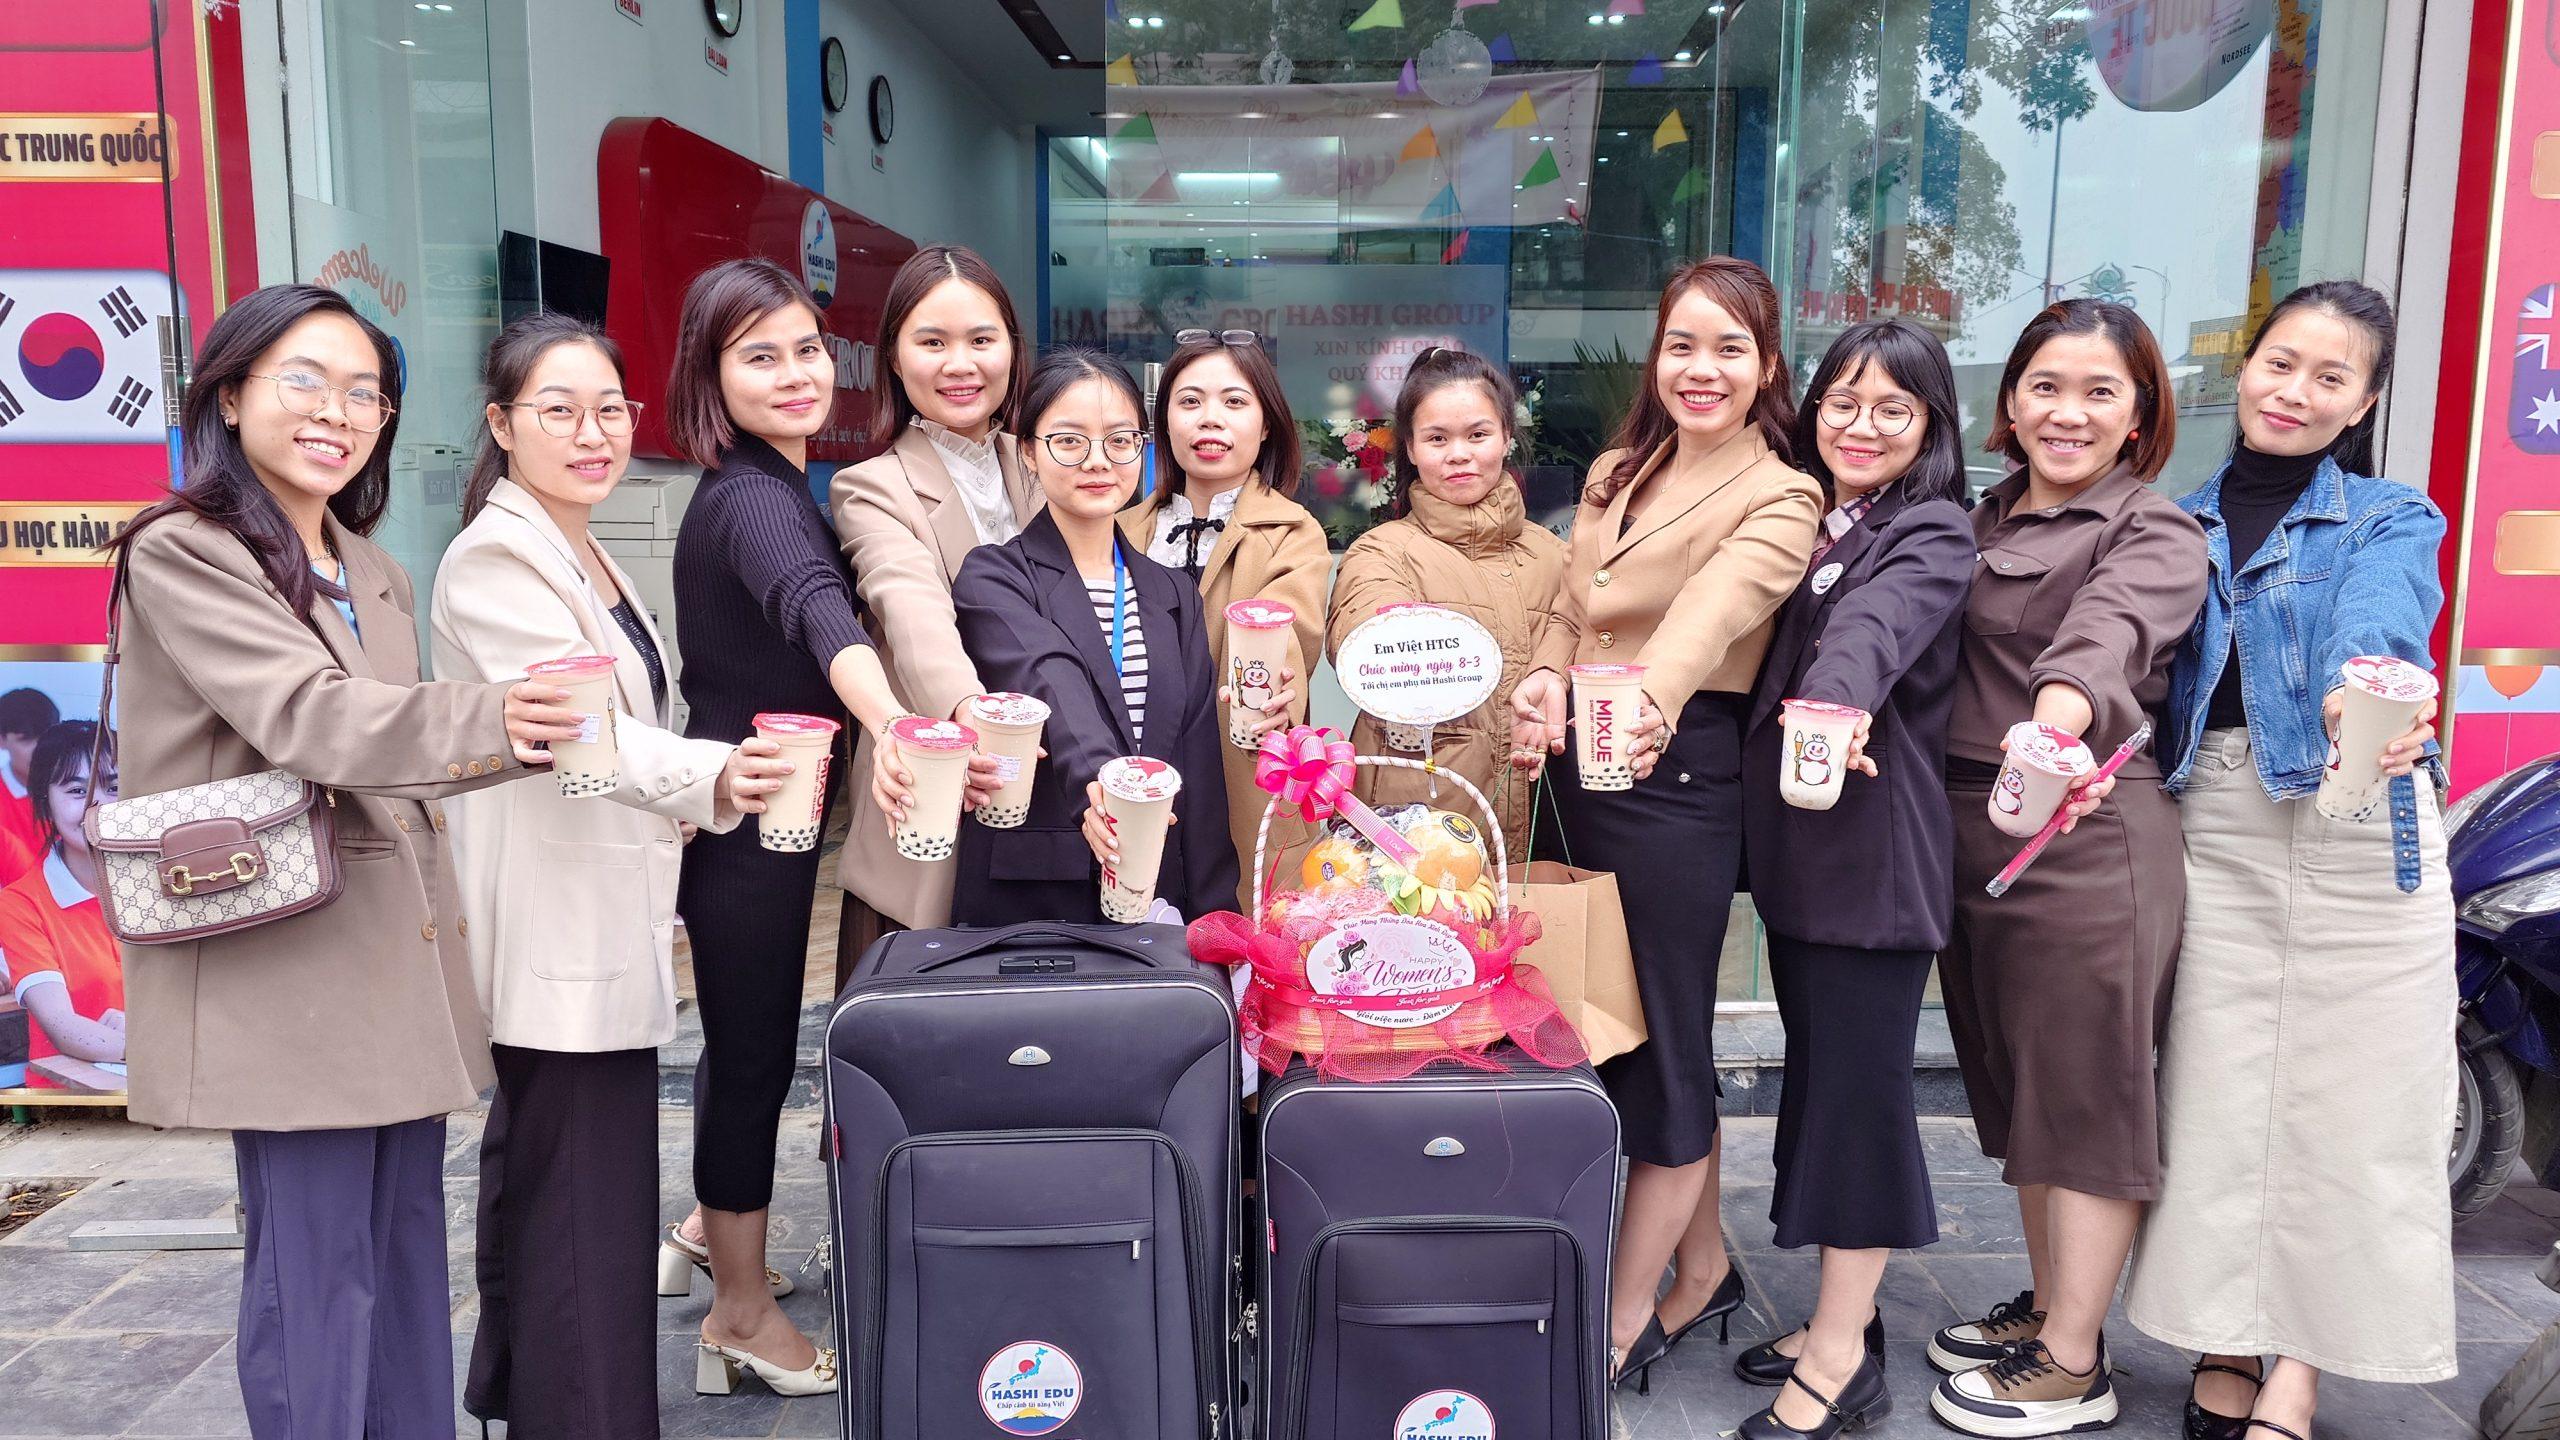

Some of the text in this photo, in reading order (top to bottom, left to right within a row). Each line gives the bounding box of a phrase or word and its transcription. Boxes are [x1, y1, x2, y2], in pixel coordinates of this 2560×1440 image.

[2221, 44, 2251, 65] NORDSEE
[15, 133, 95, 162] TRUNG
[100, 120, 162, 167] QUỐC
[1285, 303, 1495, 327] HASHI GROUP
[1314, 341, 1348, 356] XIN
[1356, 334, 1407, 356] KÍNH
[1328, 361, 1368, 382] QUÝ
[14, 521, 58, 556] HỌC
[62, 513, 111, 548] HÀN
[1374, 637, 1460, 655] Em Việt HTCS
[1359, 656, 1481, 676] Chúc mừng ngày 8-3
[1361, 682, 1375, 690] Tới
[1376, 681, 1389, 691] chị
[1403, 679, 1419, 689] phụ
[1432, 676, 1456, 685] Hashi
[1457, 674, 1483, 684] Group
[1596, 700, 1613, 762] MIXUE
[815, 756, 830, 821] MIXUE
[1408, 956, 1444, 965] HAPPY
[1366, 960, 1460, 987] Women's
[992, 1388, 1074, 1400] HASHI EDU
